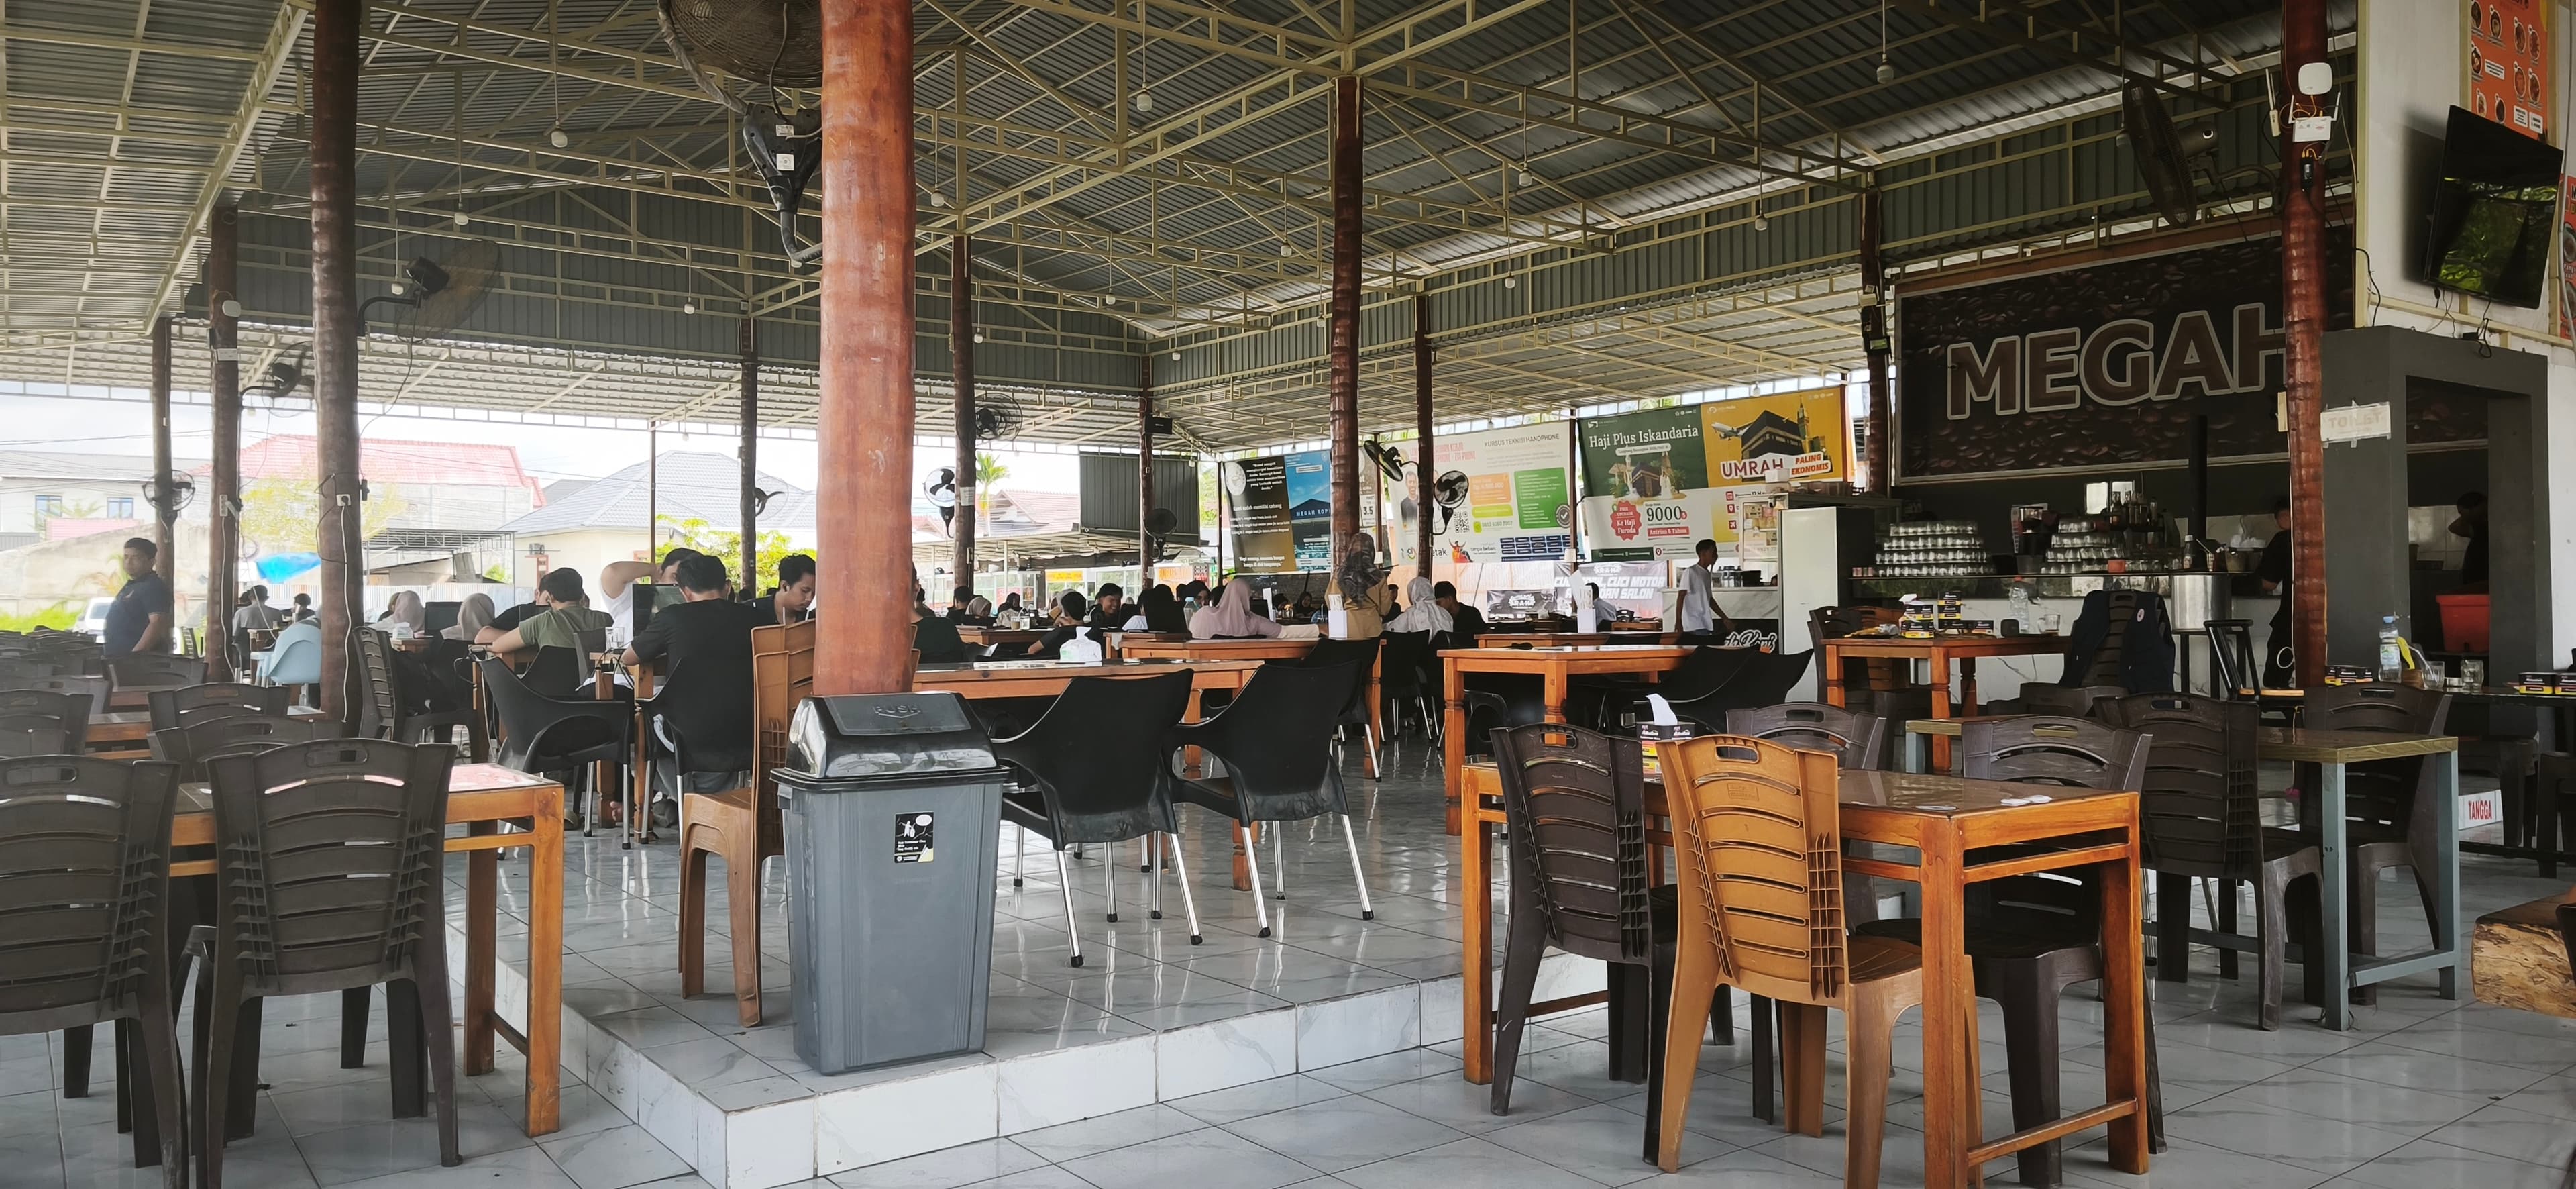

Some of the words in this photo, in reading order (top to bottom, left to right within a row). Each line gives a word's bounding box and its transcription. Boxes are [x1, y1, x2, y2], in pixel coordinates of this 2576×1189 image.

[1947, 302, 2286, 420] MEGAH
[2328, 411, 2383, 428] TOILET
[1505, 437, 1525, 445] TEKNISI
[1525, 433, 1560, 443] HANDPHONE
[1589, 433, 1611, 450] Haji
[1613, 432, 1636, 446] Plus
[1638, 425, 1699, 443] Iskandaria
[1795, 454, 1821, 465] PALING
[1722, 458, 1784, 478] UMRAH
[1791, 462, 1829, 476] EKONOMIS
[1646, 505, 1682, 521] 9000
[1617, 526, 1636, 534] Furoda
[1625, 519, 1635, 528] Haji
[1608, 576, 1630, 587] CUCI
[1631, 576, 1666, 588] MOTOR
[1620, 588, 1654, 599] SALON
[2468, 799, 2492, 821] TANGGA
